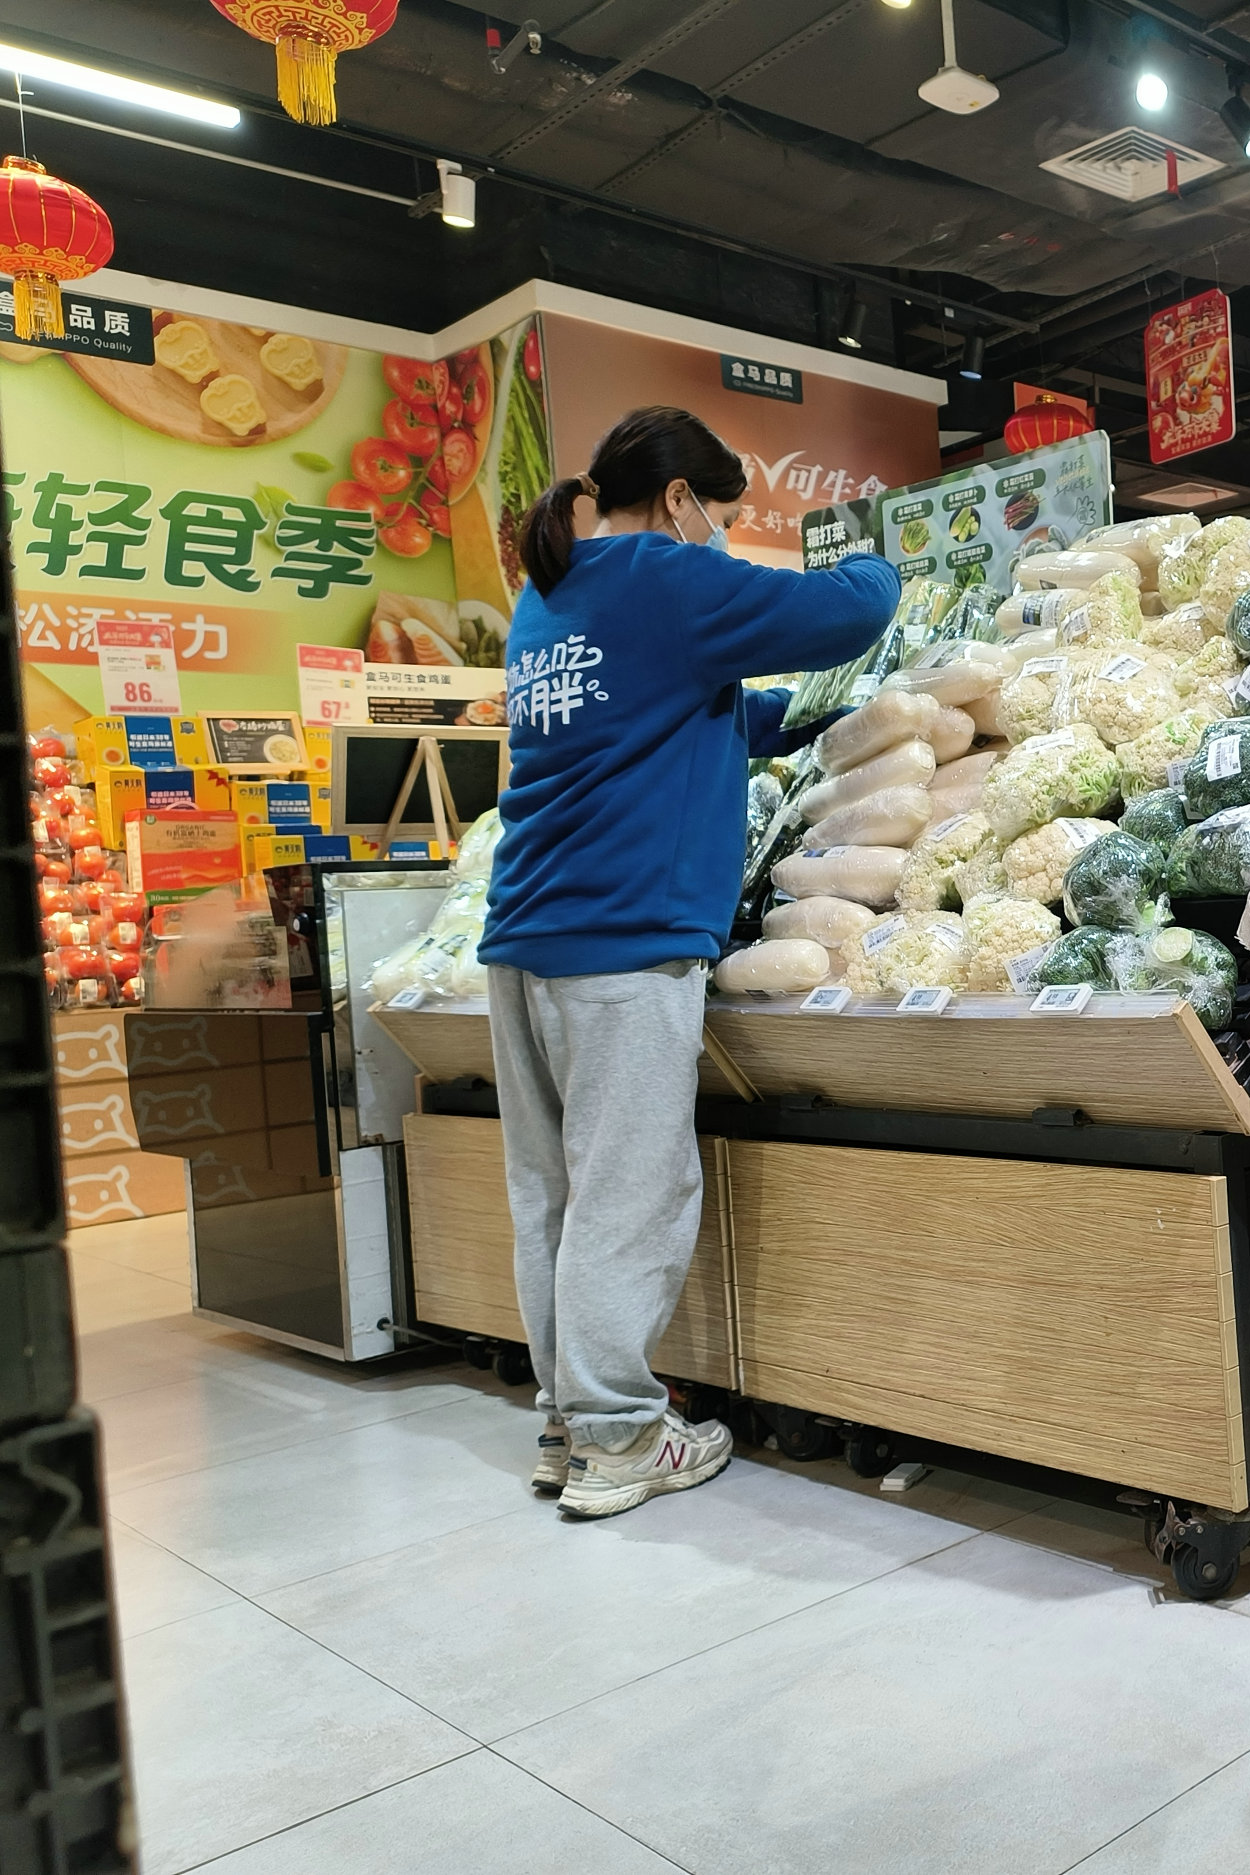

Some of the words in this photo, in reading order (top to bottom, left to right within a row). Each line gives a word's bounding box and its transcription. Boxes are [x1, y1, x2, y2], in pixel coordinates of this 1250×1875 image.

[93, 338, 133, 353] Quality
[731, 361, 793, 388] 盒马品质
[806, 520, 847, 549] 霜打菜
[366, 671, 451, 685] 盒马可生食鸡蛋
[124, 682, 152, 703] 86
[655, 1440, 686, 1470] N
